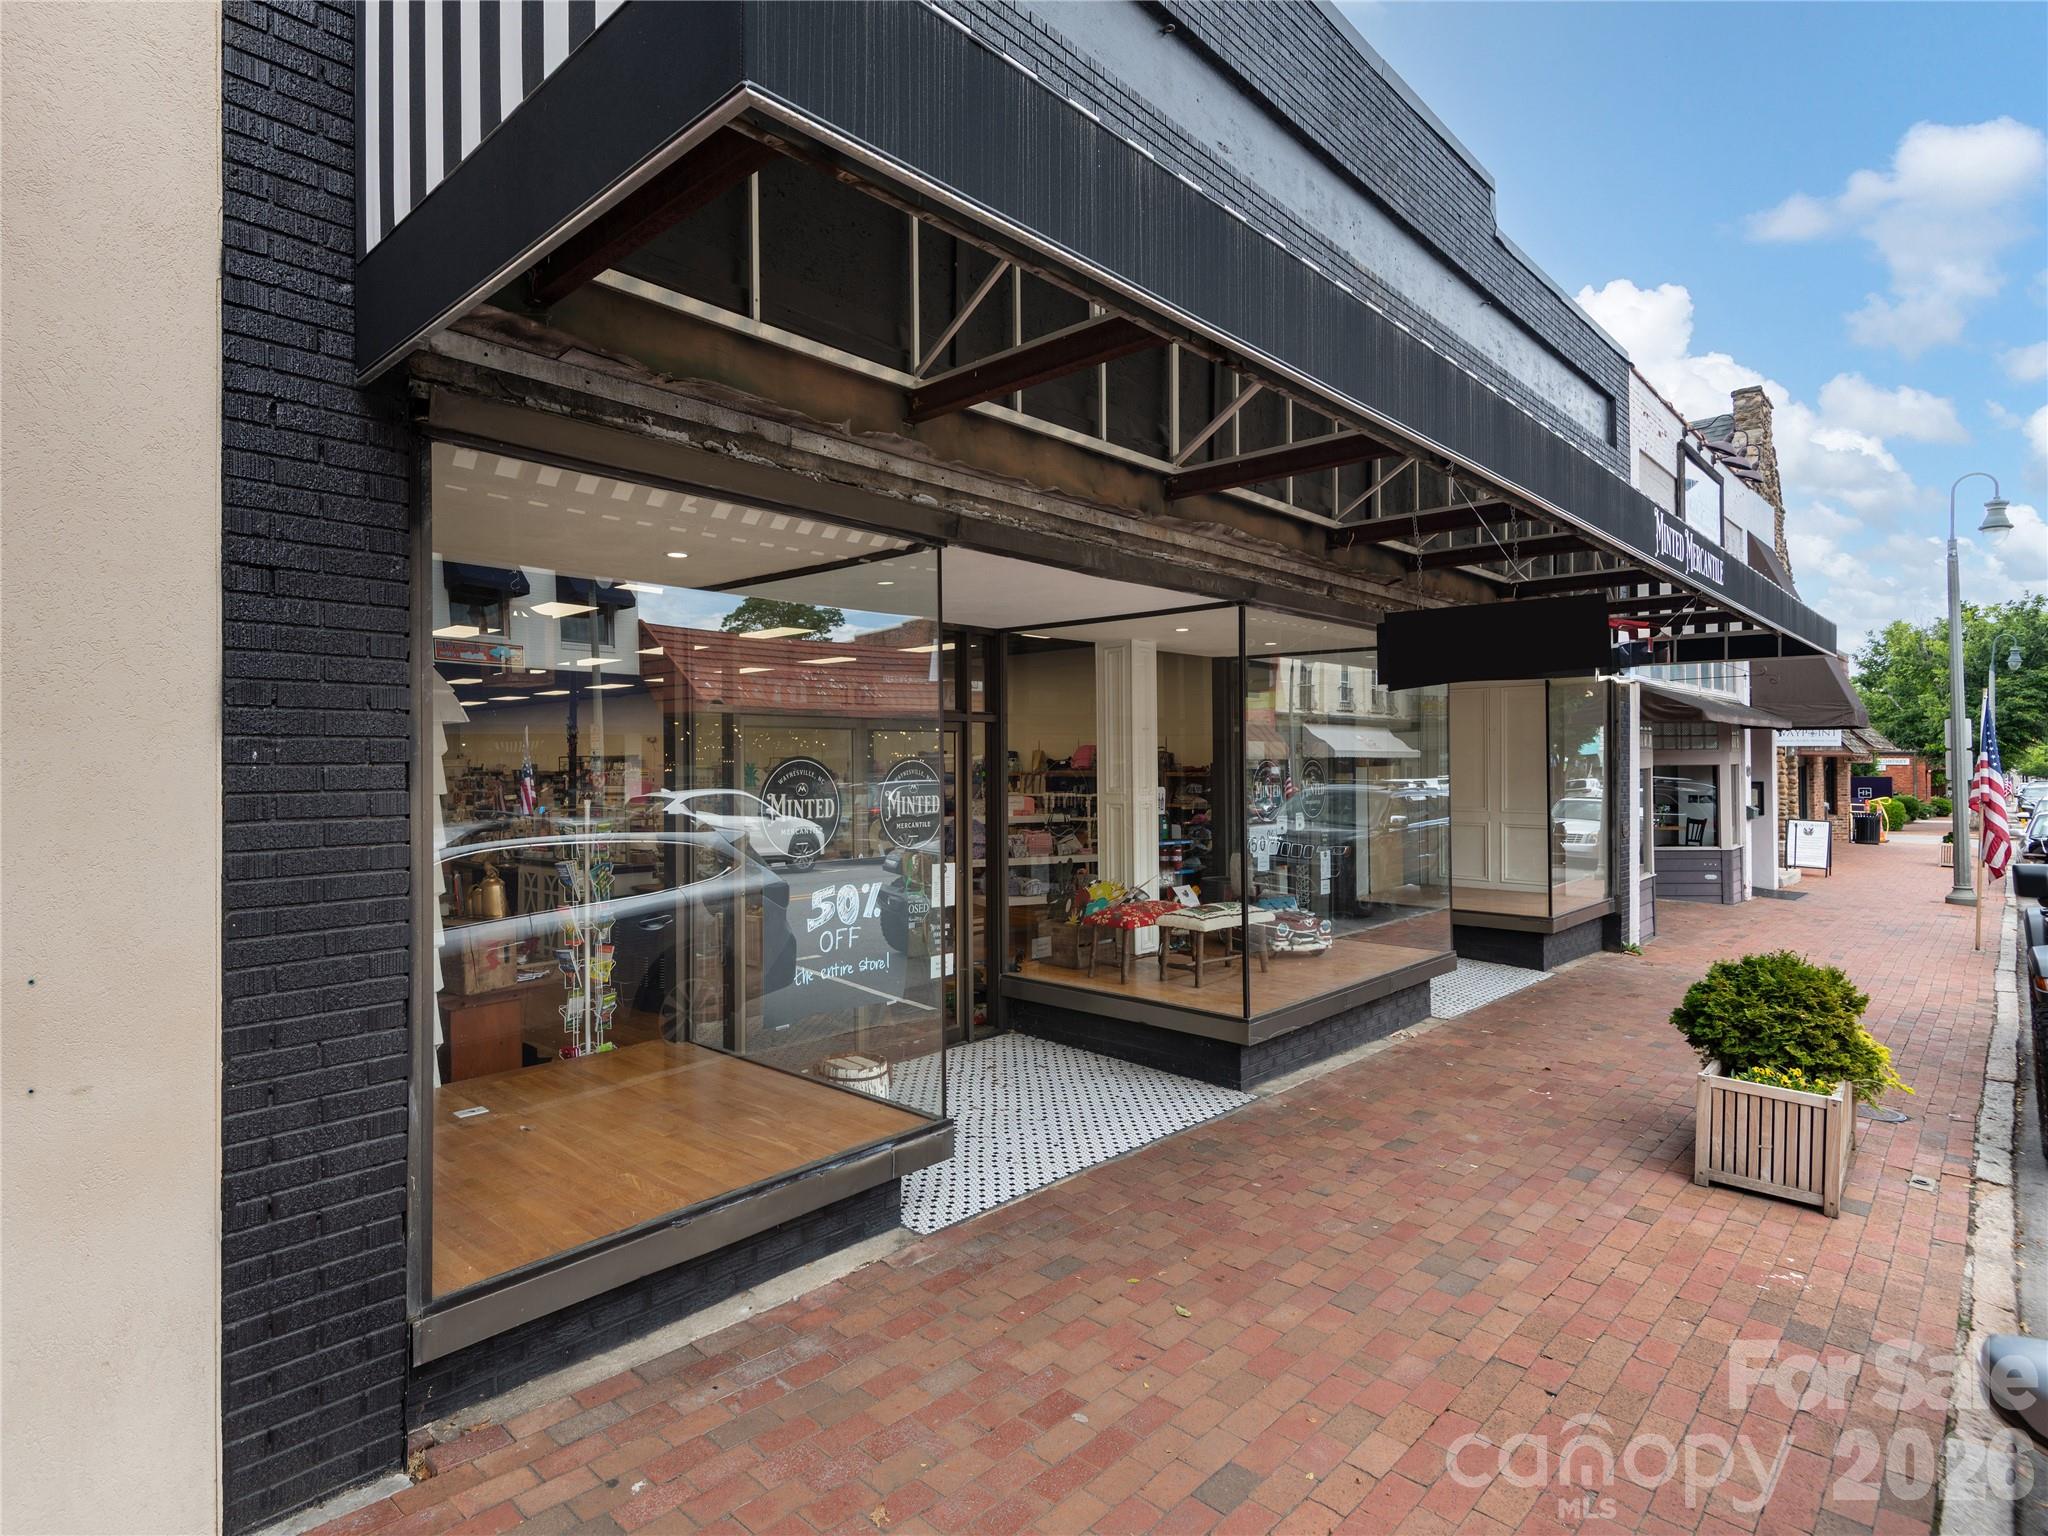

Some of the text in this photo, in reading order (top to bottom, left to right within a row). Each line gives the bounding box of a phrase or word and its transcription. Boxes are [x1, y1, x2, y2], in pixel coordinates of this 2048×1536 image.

[1654, 507, 1724, 586] MINTED MERCANTILE
[766, 793, 835, 827] MINTED
[885, 790, 940, 822] MINTED
[897, 821, 931, 829] MERCANTILE
[807, 882, 882, 933] 50%
[908, 903, 929, 914] OSED
[820, 926, 861, 953] OFF
[794, 952, 890, 986] the entire store!
